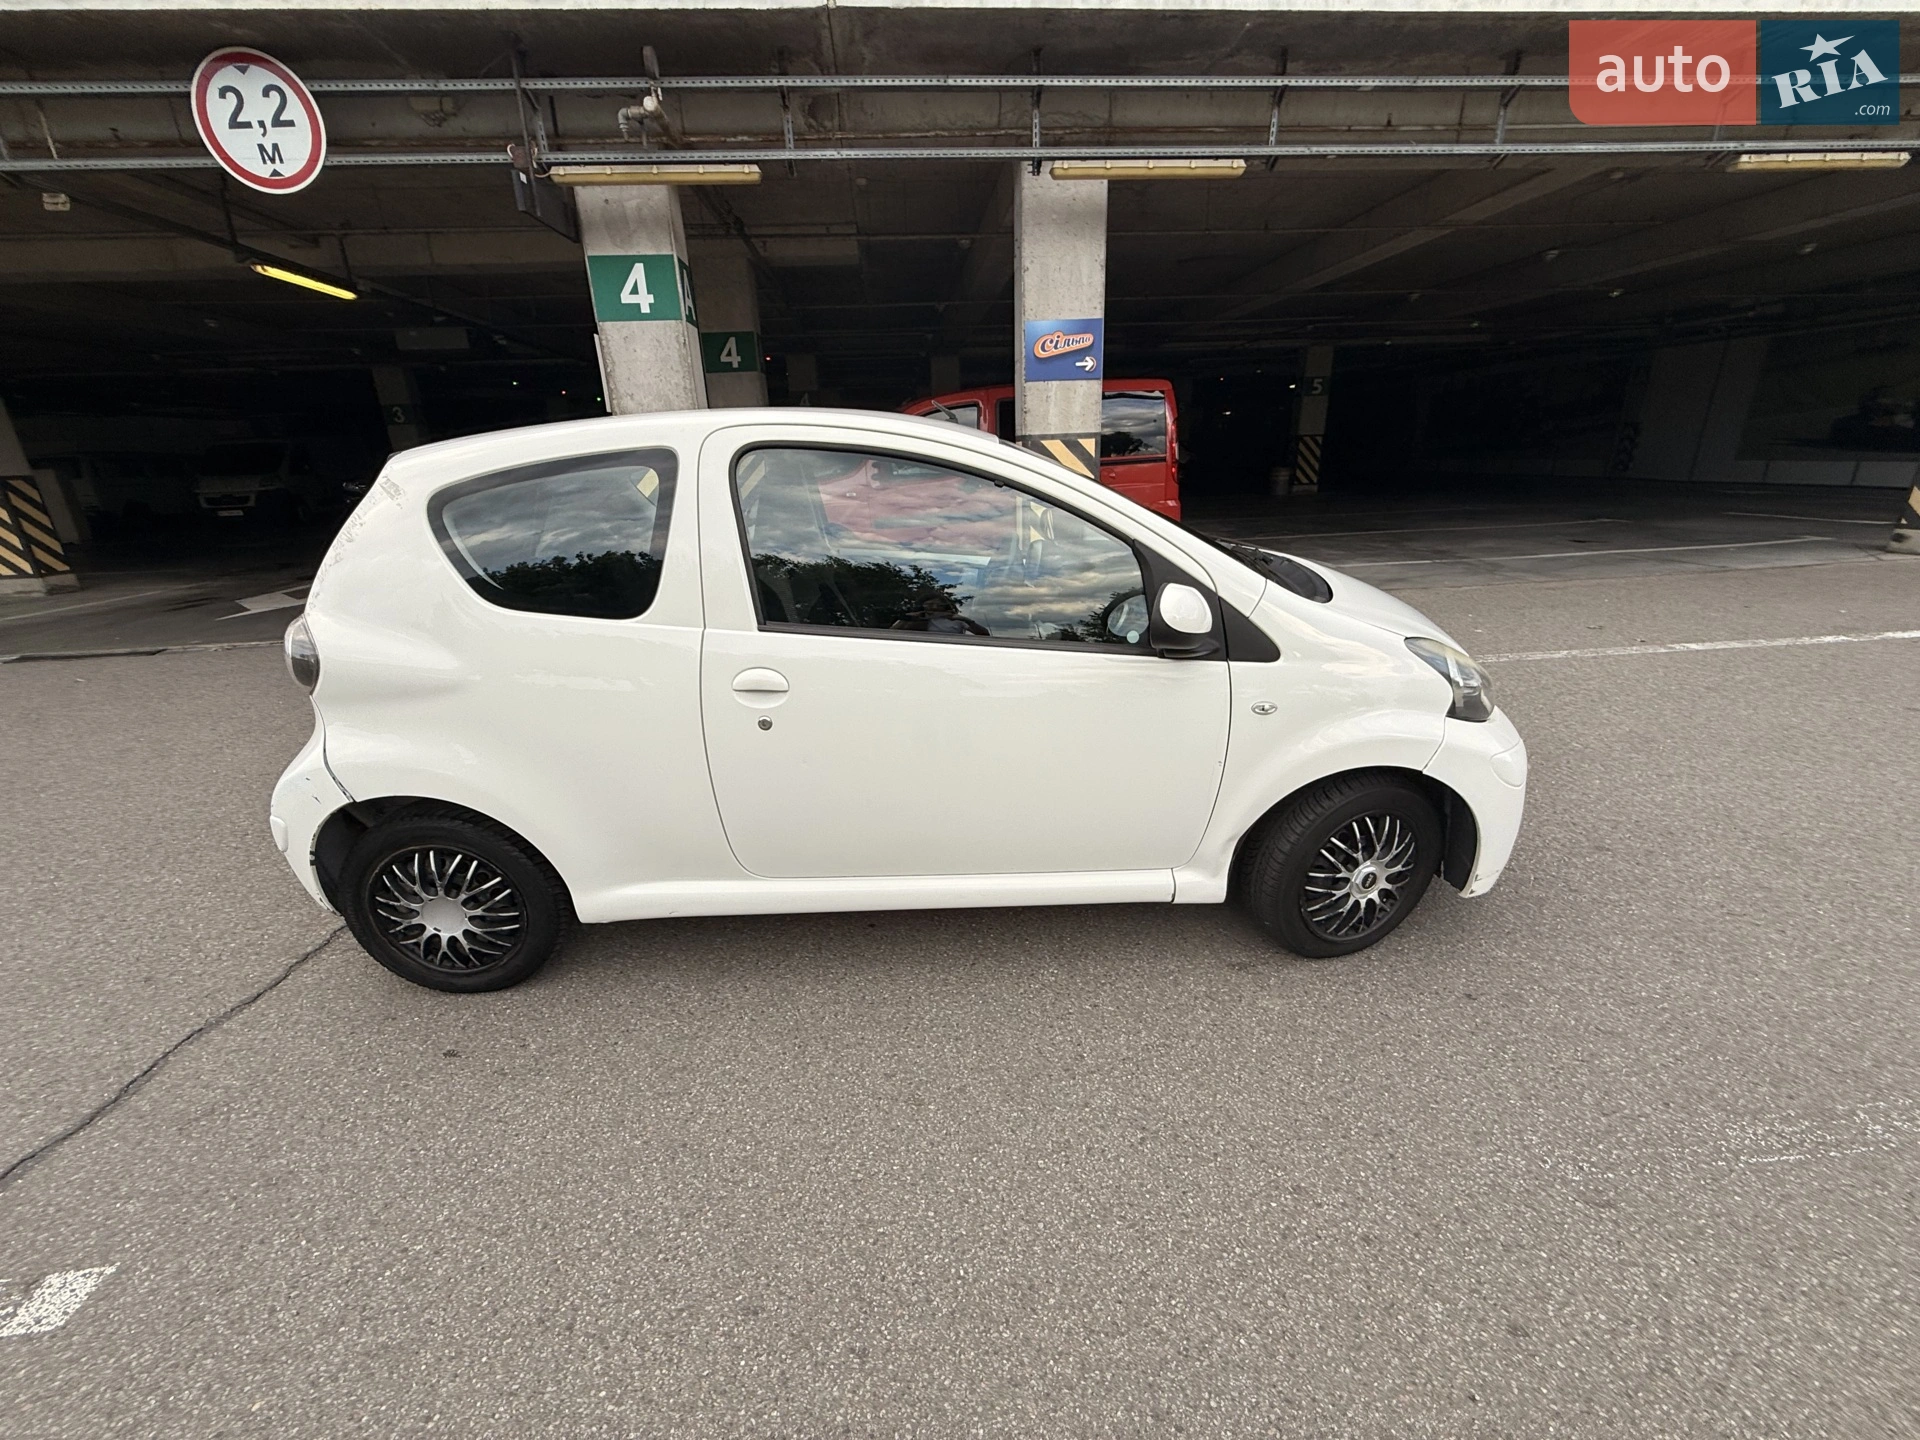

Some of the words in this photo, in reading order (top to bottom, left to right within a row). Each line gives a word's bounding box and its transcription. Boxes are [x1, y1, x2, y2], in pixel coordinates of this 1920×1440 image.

[218, 84, 296, 138] 2,2
[620, 262, 655, 314] 4
[719, 336, 742, 369] 4
[1311, 378, 1323, 395] 5
[392, 406, 405, 423] 3
